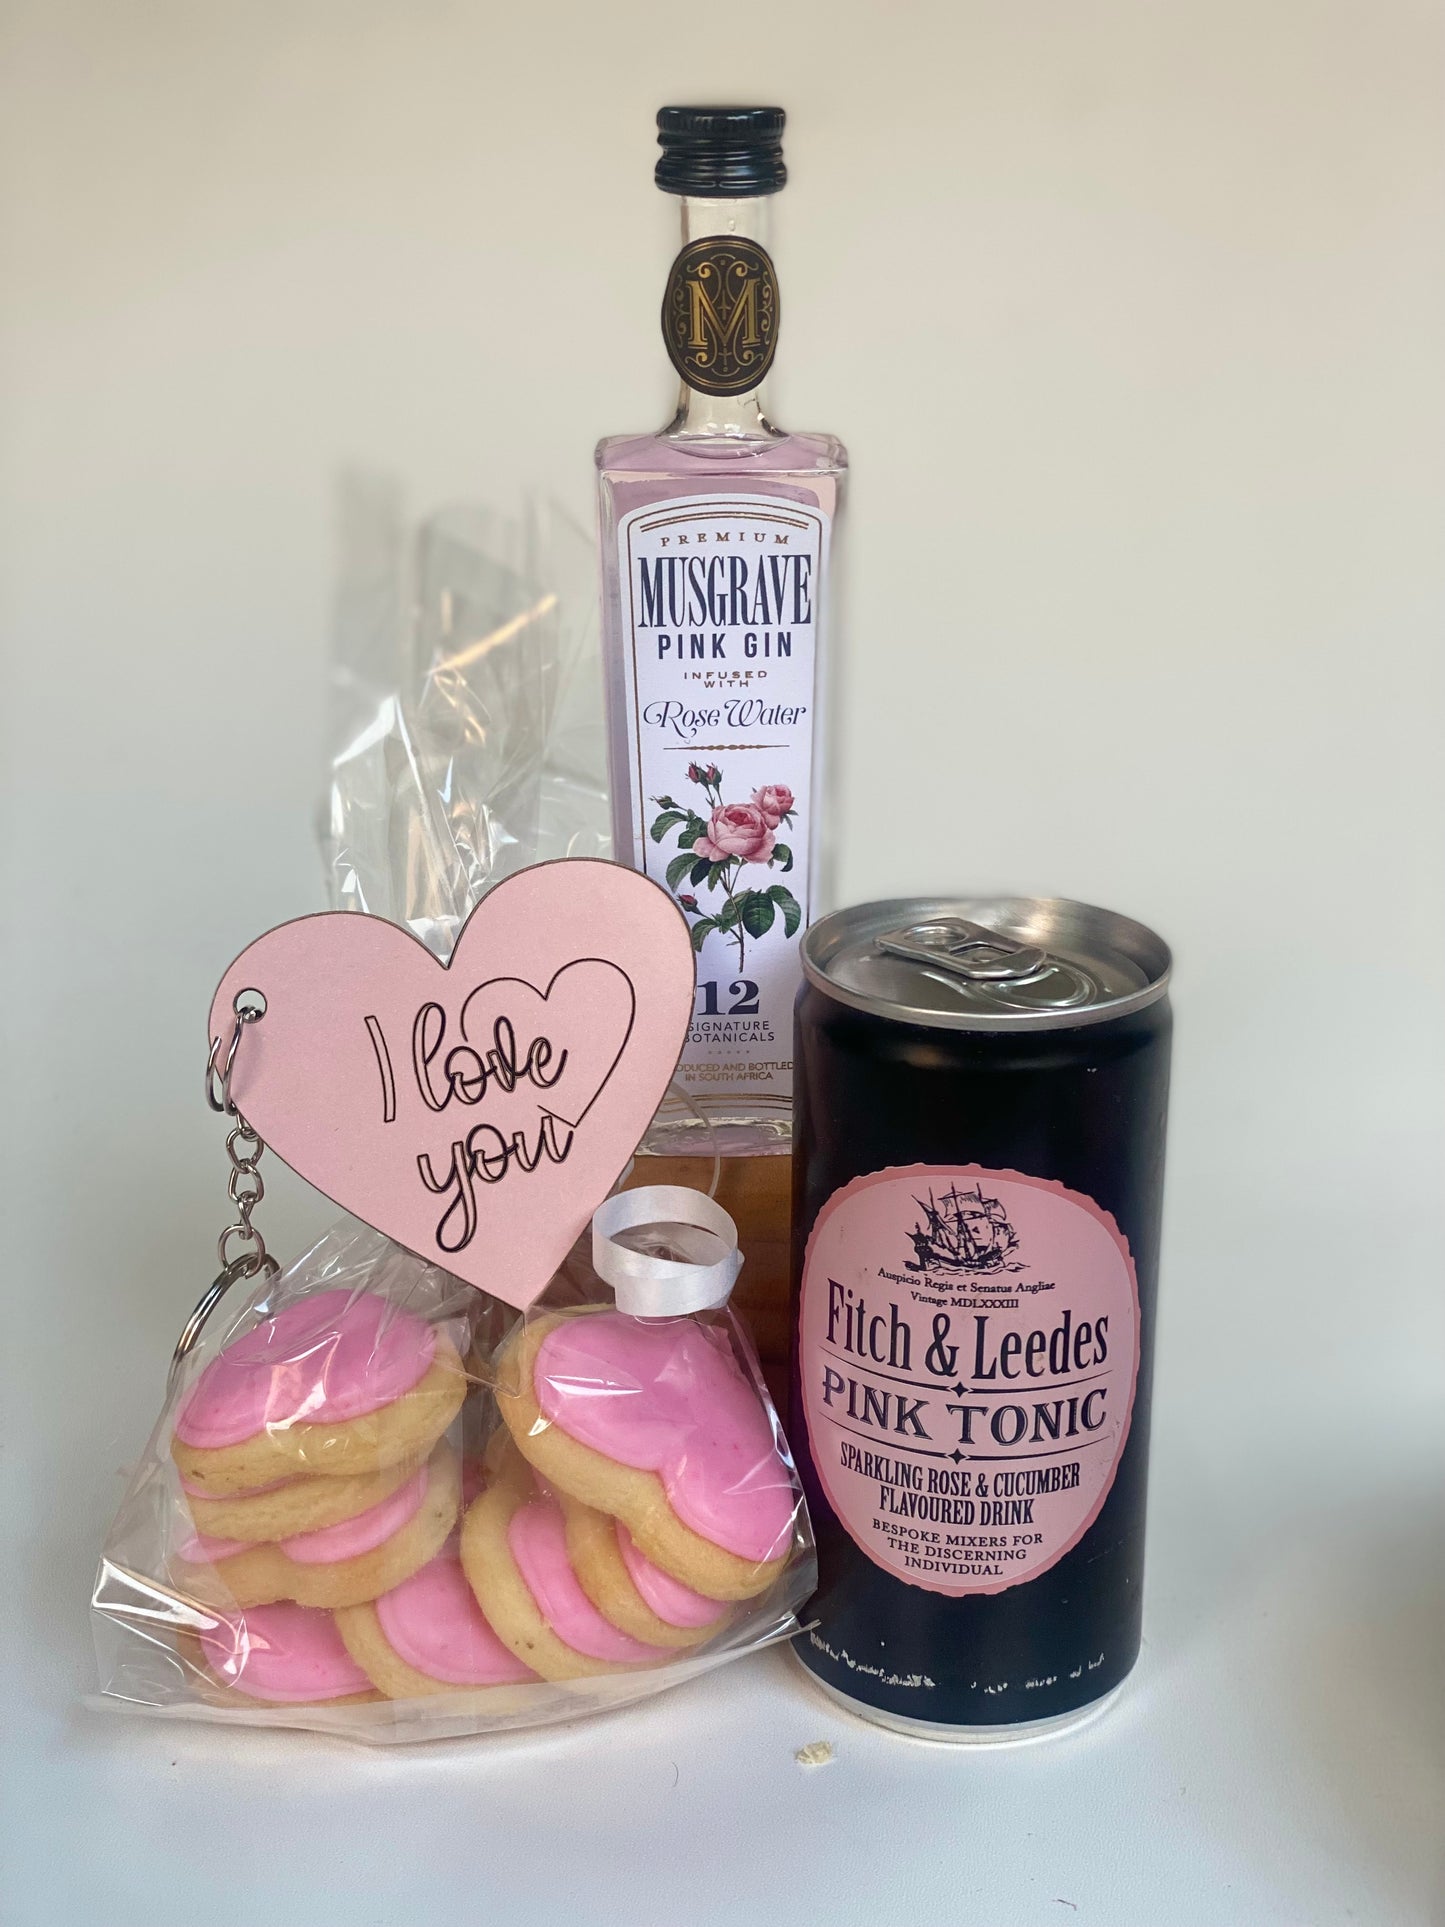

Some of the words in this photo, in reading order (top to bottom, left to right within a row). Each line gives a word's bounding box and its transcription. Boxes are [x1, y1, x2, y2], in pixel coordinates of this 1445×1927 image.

[661, 532, 790, 547] PREMIUM
[637, 554, 811, 628] MUSGRAVE
[658, 633, 726, 659] PINK
[744, 632, 792, 658] GIN
[684, 670, 768, 680] INFUSED
[704, 680, 749, 689] WITH
[643, 700, 720, 739] Rose
[724, 699, 806, 728] Water
[697, 980, 760, 1015] 12
[364, 1015, 396, 1122] I
[412, 1001, 568, 1112] love
[676, 1063, 721, 1072] ODUCED
[722, 1063, 746, 1072] AND
[748, 1061, 794, 1071] BOTTLED
[685, 1073, 696, 1081] IN
[699, 1072, 734, 1081] SOUTH
[736, 1071, 774, 1081] AFRICA
[417, 1115, 574, 1253] you
[878, 1267, 921, 1286] Auspicio
[925, 1278, 953, 1292] Regis
[957, 1284, 967, 1292] et
[970, 1283, 1012, 1293] Senatus
[1015, 1281, 1056, 1294] Angliae
[911, 1291, 948, 1307] Vintage
[950, 1297, 1019, 1308] MDLXXXIII
[826, 1277, 912, 1371] Fitch
[925, 1312, 960, 1378] &
[971, 1309, 1109, 1380] Leedes
[822, 1366, 933, 1440] PINK
[946, 1388, 1108, 1446] TONIC
[840, 1441, 922, 1492] SPARKLING
[928, 1467, 970, 1497] ROSE
[975, 1474, 989, 1498] &
[993, 1462, 1080, 1498] CUCUMBER
[879, 1485, 975, 1526] FLAVOURED
[979, 1499, 1035, 1526] DRINK
[872, 1518, 941, 1544] BESPOKE
[945, 1534, 1007, 1547] MIXERS
[1013, 1533, 1043, 1546] FOR
[887, 1537, 920, 1555] THE
[924, 1545, 1027, 1561] DISCERNING
[904, 1556, 1003, 1575] INDIVIDUAL
